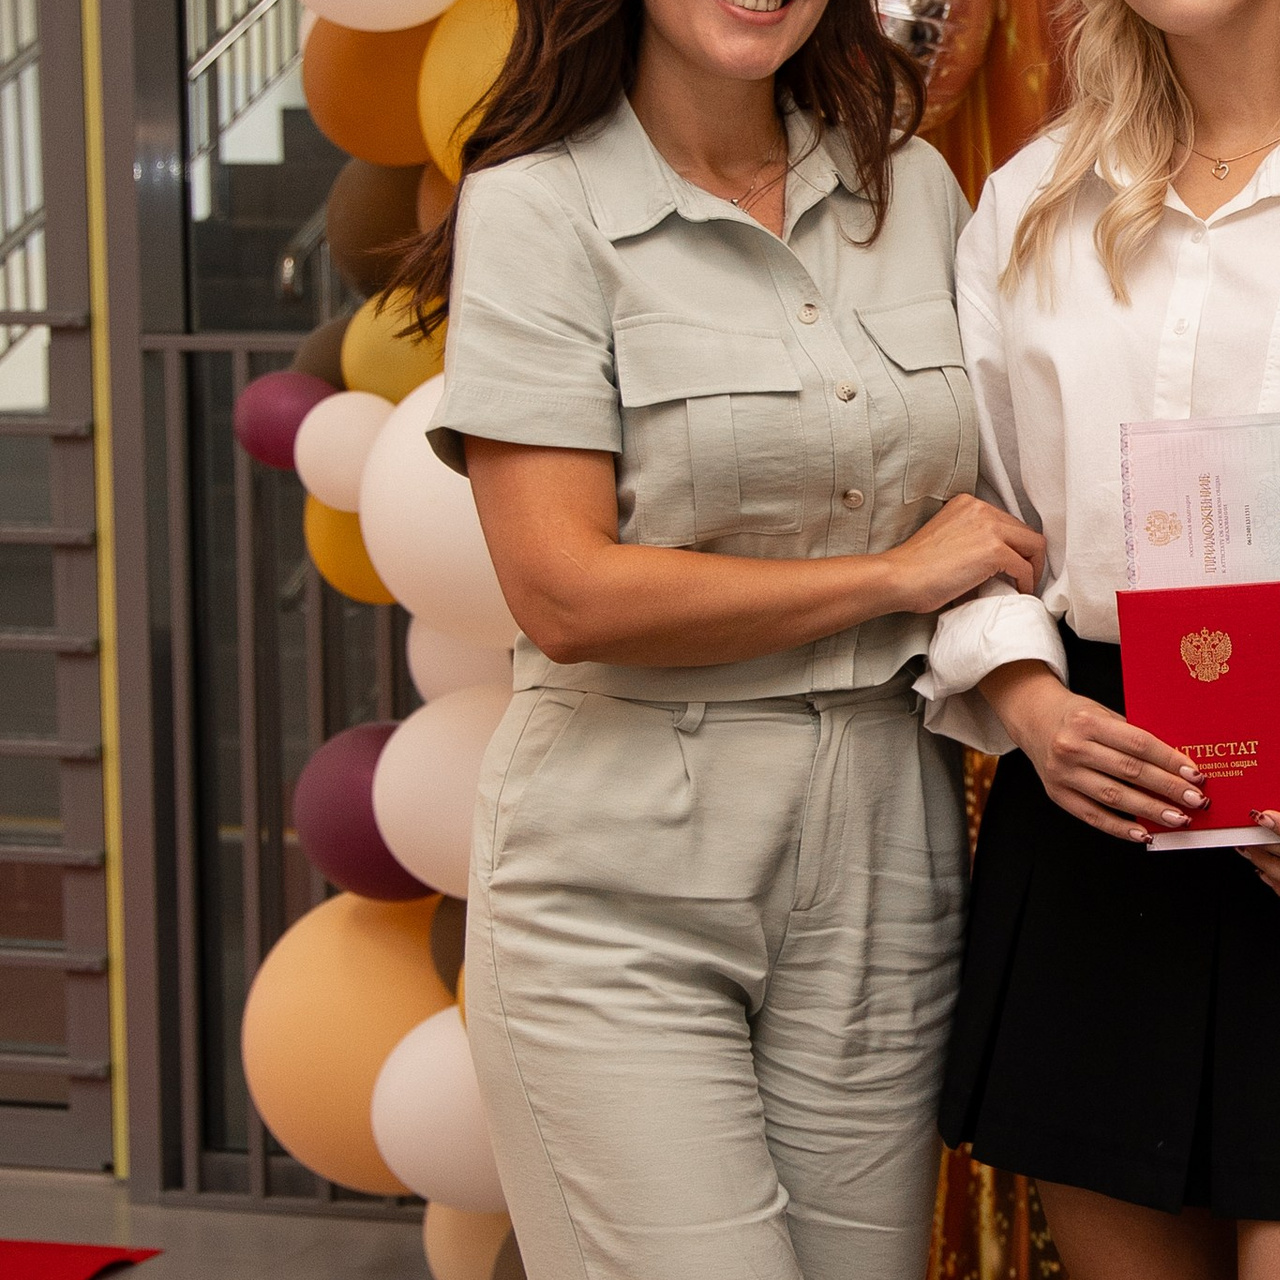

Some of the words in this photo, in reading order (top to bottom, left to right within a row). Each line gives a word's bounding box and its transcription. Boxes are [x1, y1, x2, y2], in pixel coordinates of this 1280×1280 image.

[1198, 472, 1216, 573] ПРИЛОЖЕНИЕ
[1174, 741, 1259, 758] ТТЕСТАТ
[1230, 759, 1258, 768] ОБЩЕМ
